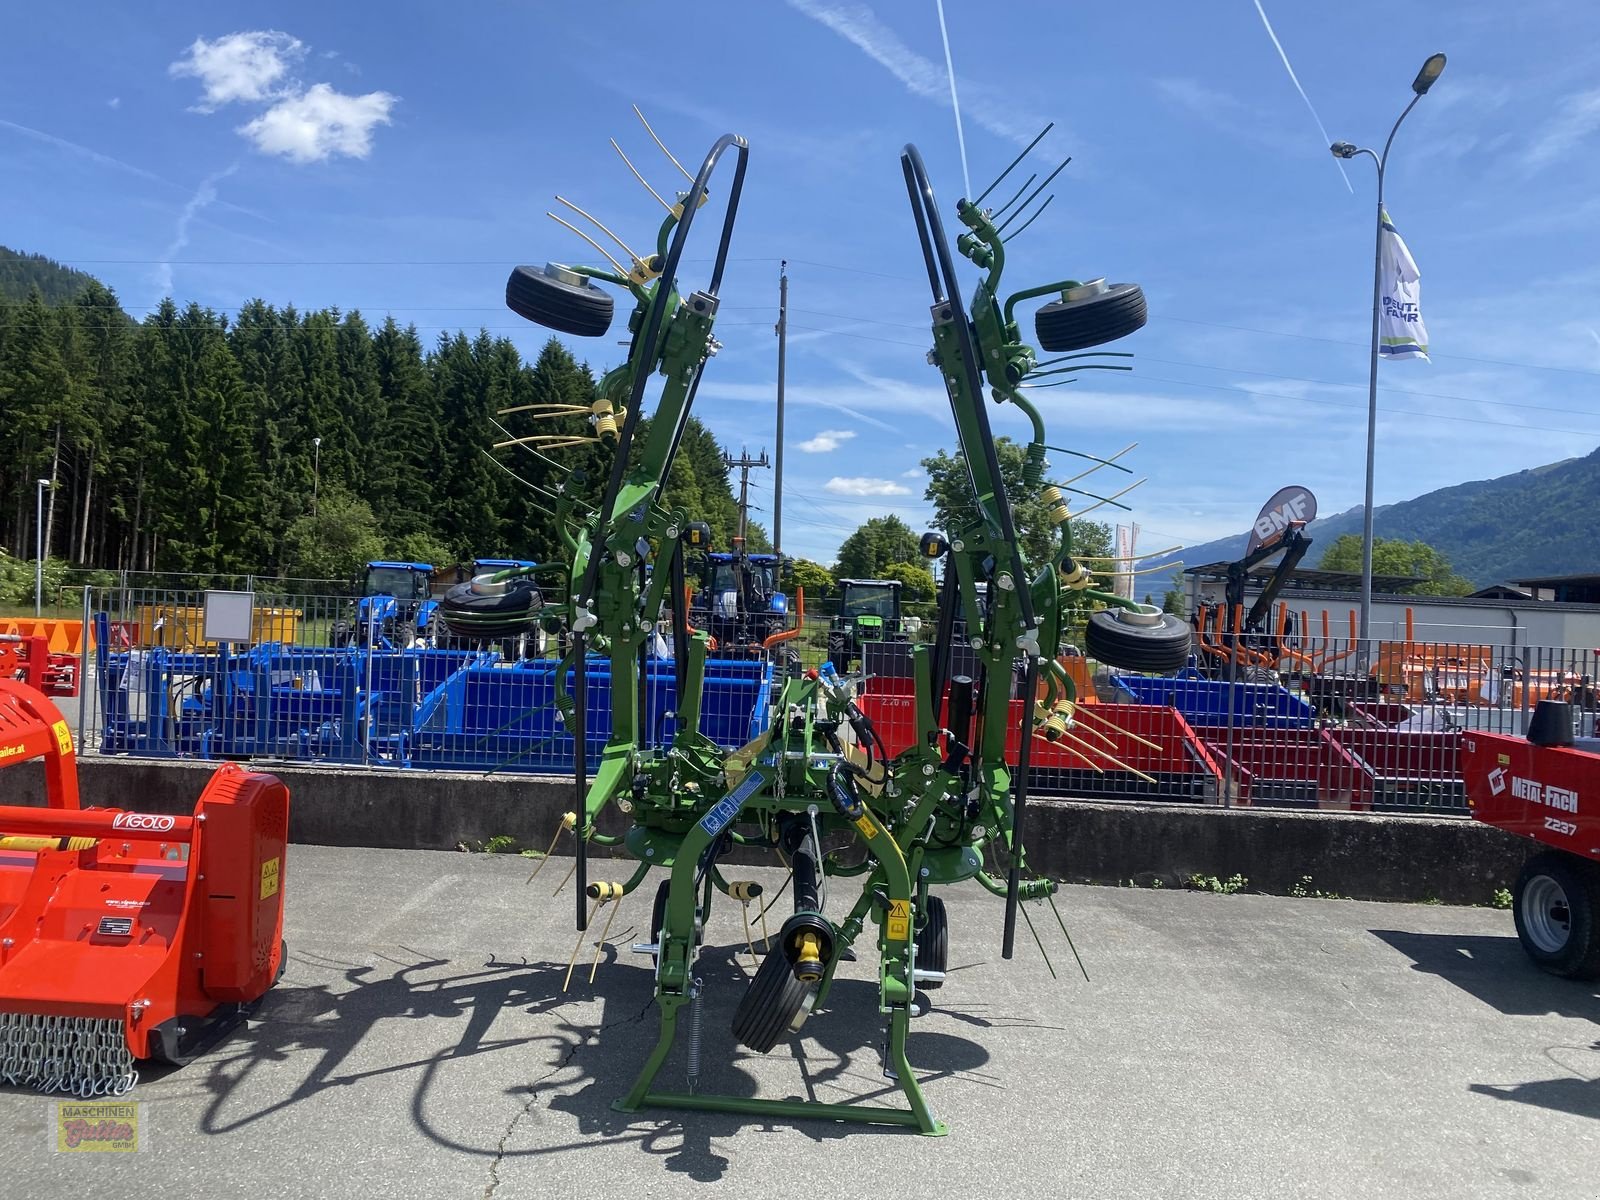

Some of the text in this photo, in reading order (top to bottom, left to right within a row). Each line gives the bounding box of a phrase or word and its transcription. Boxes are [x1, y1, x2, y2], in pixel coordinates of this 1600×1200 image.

[1383, 296, 1417, 312] DEUT
[1386, 307, 1418, 322] FAHR
[1255, 493, 1306, 540] BMF
[1512, 776, 1578, 813] METAL-FACH
[114, 814, 174, 830] VIGOLO
[1544, 816, 1577, 836] Z237
